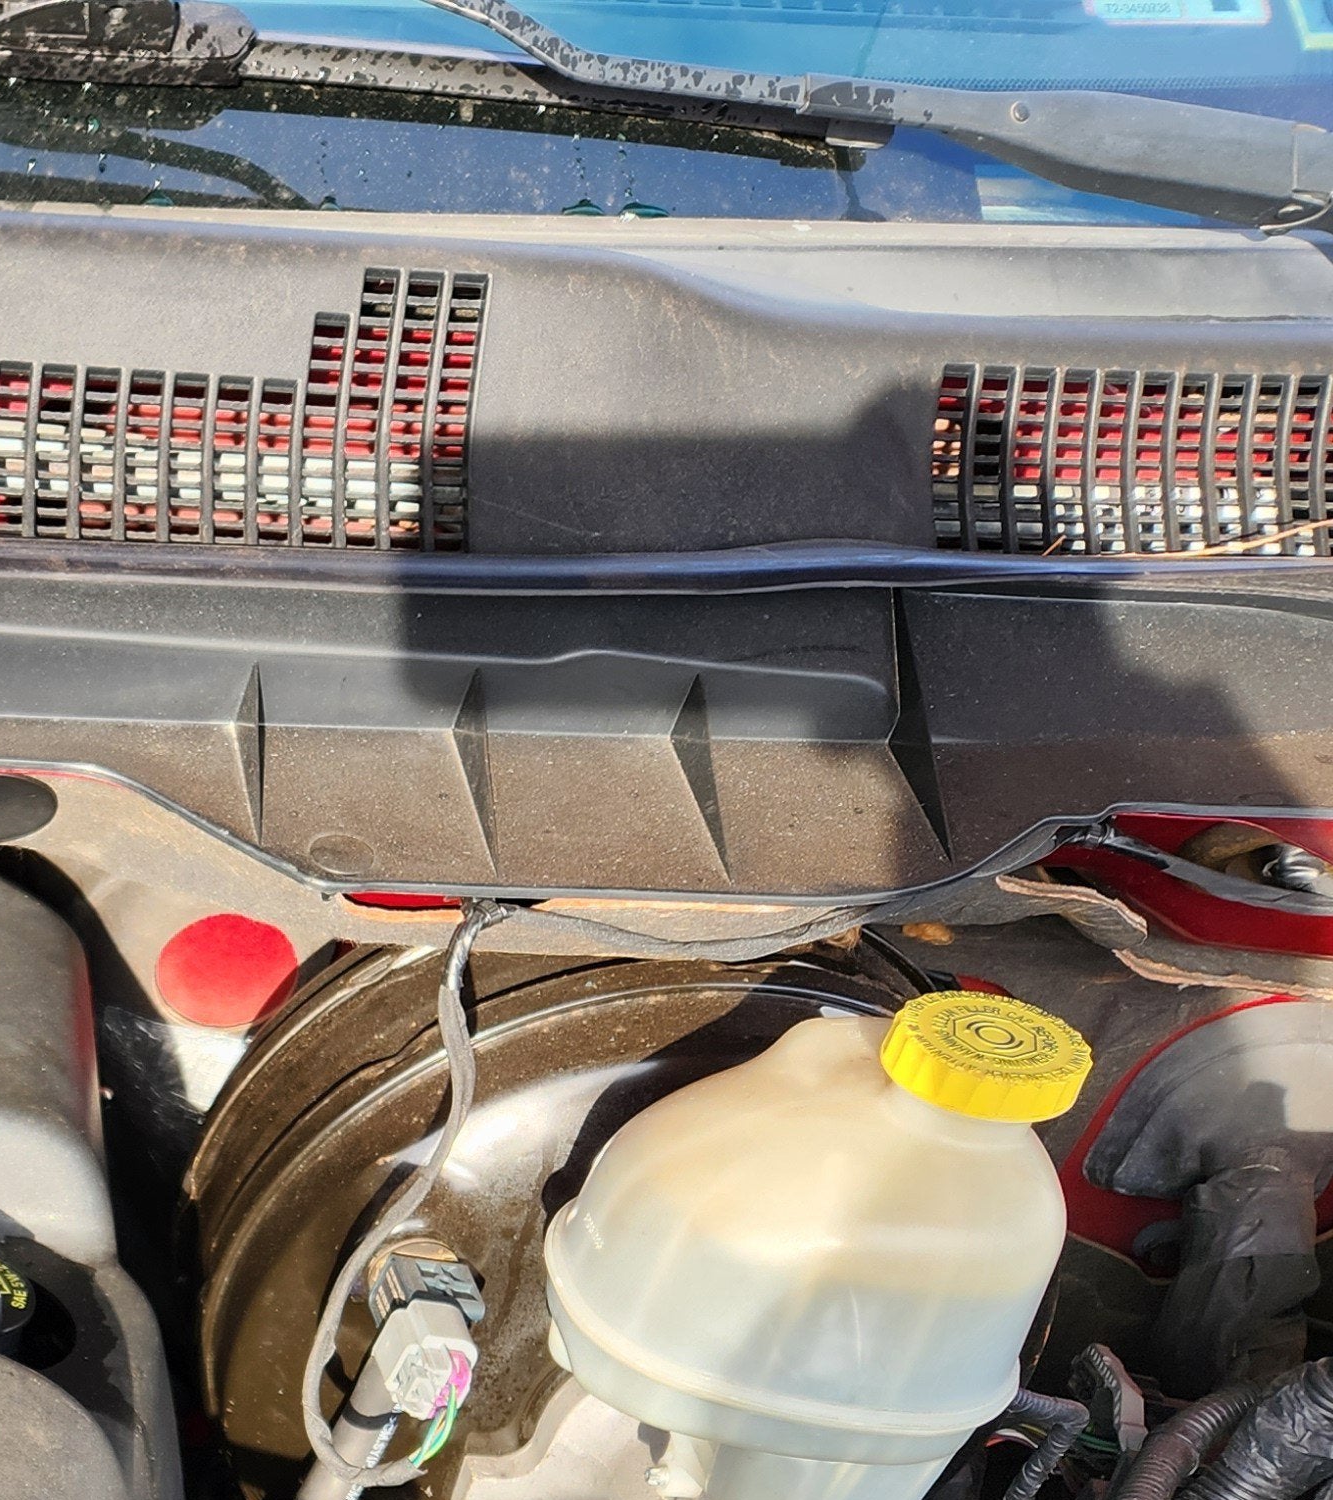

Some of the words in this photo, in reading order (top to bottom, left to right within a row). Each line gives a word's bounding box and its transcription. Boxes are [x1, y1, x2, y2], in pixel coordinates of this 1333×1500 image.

[952, 1004, 1000, 1014] FILLER
[1006, 1010, 1035, 1025] CAP
[10, 1289, 28, 1310] SAE
